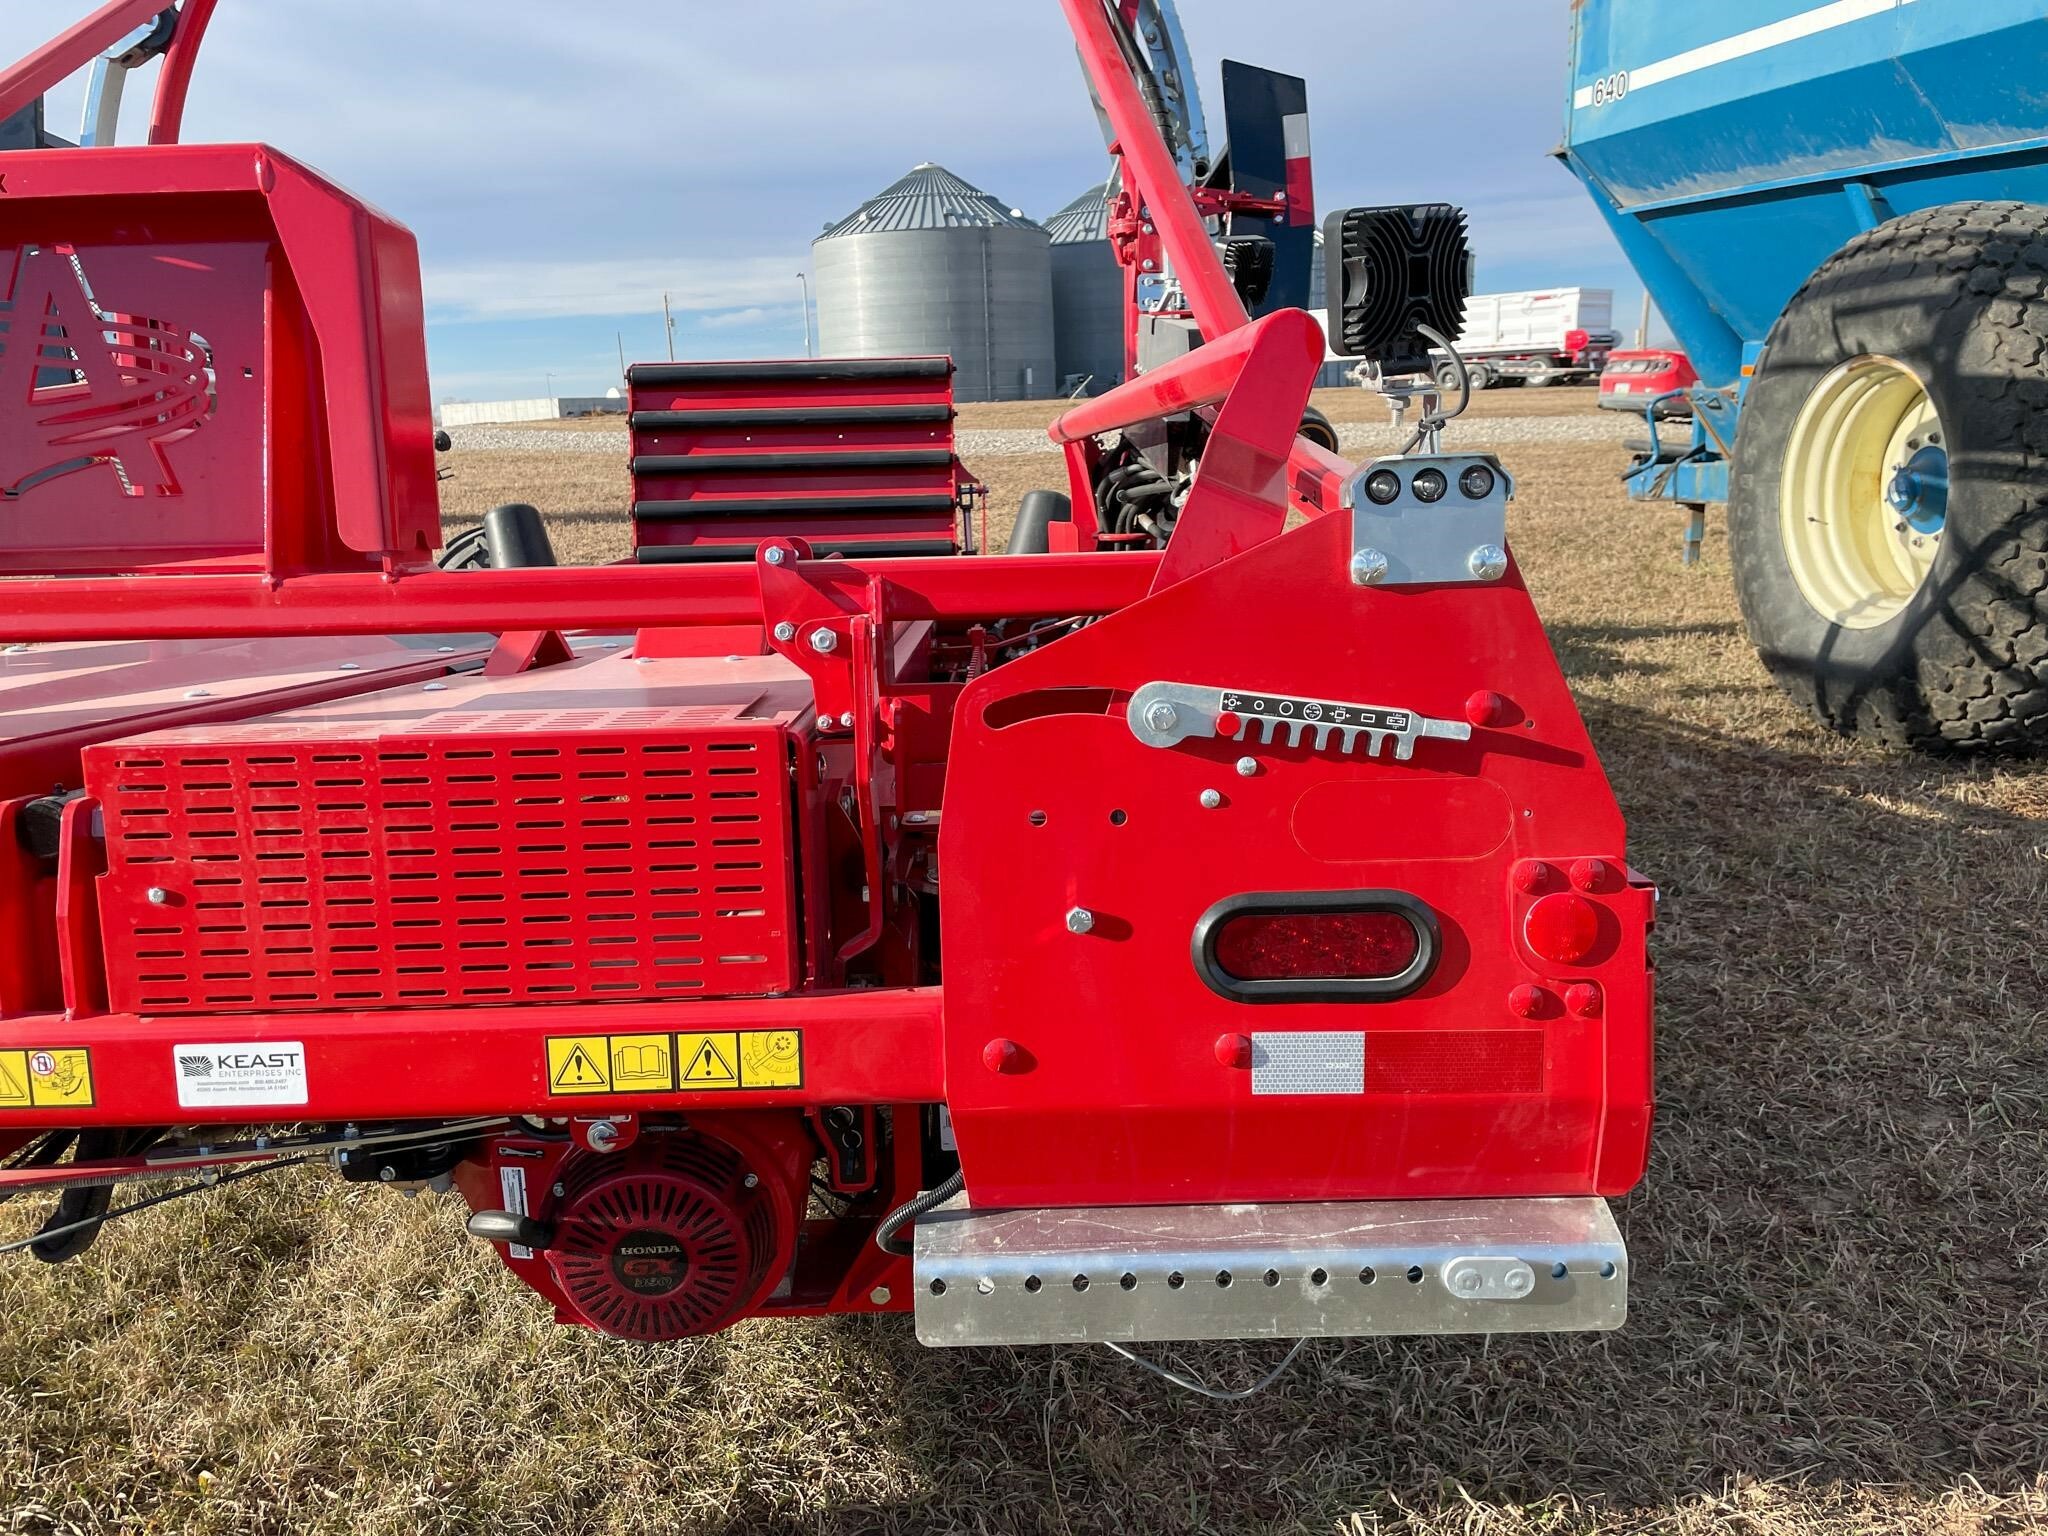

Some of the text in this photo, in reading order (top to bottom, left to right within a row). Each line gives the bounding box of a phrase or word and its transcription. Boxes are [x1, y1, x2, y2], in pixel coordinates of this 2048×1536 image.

[1595, 71, 1628, 106] 640
[217, 1053, 299, 1069] KEAST
[219, 1068, 302, 1078] ENTERPRISES INC
[620, 1246, 681, 1255] HONDA
[624, 1258, 678, 1276] GX
